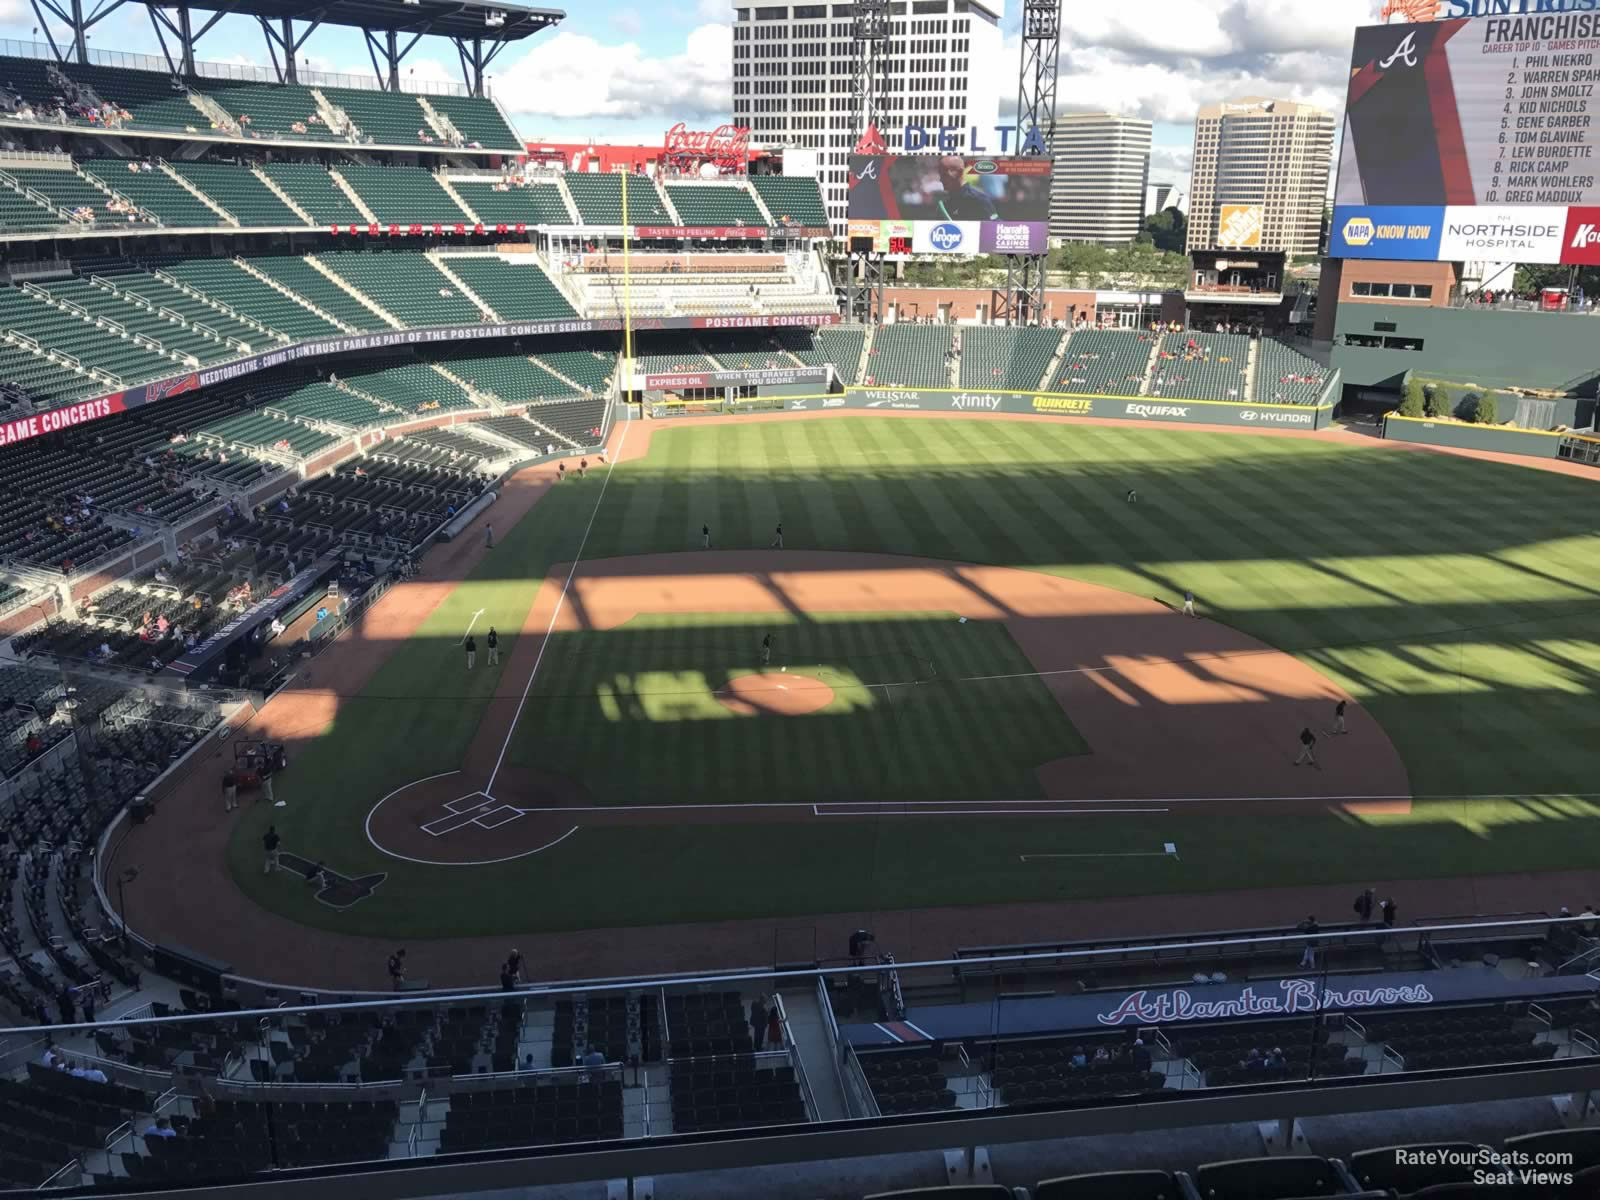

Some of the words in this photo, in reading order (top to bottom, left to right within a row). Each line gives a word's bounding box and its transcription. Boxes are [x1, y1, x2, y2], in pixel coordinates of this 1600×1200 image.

[1482, 43, 1513, 54] CAREER
[1515, 42, 1530, 53] TOP
[1532, 41, 1540, 52] 10
[1547, 40, 1576, 51] GAMES
[1512, 56, 1519, 69] 1.
[1525, 55, 1549, 68] PHIL
[1552, 53, 1592, 67] NIEKRO
[1507, 72, 1517, 84] 2.
[1523, 70, 1569, 84] WARREN
[1505, 87, 1515, 99] 3.
[1521, 87, 1549, 99] JOHN
[1551, 85, 1593, 98] SMOLTZ
[1503, 102, 1512, 114] 4.
[1519, 101, 1537, 114] KID
[1539, 100, 1587, 113] NICHOLS
[1501, 117, 1510, 129] 5.
[1516, 116, 1544, 129] GENE
[1547, 115, 1591, 128] GARBER
[904, 125, 1047, 154] DELTA
[1498, 132, 1508, 144] 6.
[1515, 131, 1538, 143] TOM
[1540, 130, 1585, 143] GLAVINE
[1499, 147, 1506, 159] 7.
[1512, 146, 1535, 158] LEW
[1537, 145, 1592, 158] BURDETTE
[1494, 161, 1504, 173] 8.
[1509, 161, 1535, 173] RICK
[1537, 160, 1569, 173] CAMP
[1491, 176, 1501, 188] 9.
[1507, 175, 1539, 188] MARK
[1541, 175, 1594, 188] WOHLERS
[1485, 190, 1500, 203] 10.
[1505, 190, 1534, 203] GREG
[1535, 190, 1583, 203] MADDUX
[648, 228, 670, 236] TASTE
[672, 228, 685, 236] THE
[687, 228, 716, 236] FEELING
[932, 227, 961, 248] Kroger
[1347, 225, 1370, 238] NAPA
[1376, 224, 1406, 239] KNOW
[1407, 225, 1431, 239] HOW
[1449, 224, 1559, 238] NORTHSIDE
[1465, 239, 1535, 249] HOSPITAL
[705, 317, 769, 328] POSTGAME
[772, 314, 832, 327] CONCERTS
[200, 358, 258, 386] NEEDTOBREATHE
[263, 351, 287, 368] COMING
[288, 350, 295, 360] TO
[296, 340, 341, 358] SUNTRUST
[343, 337, 367, 350] PARK
[369, 336, 381, 347] AS
[383, 333, 404, 345] PART
[408, 332, 422, 342] OF
[426, 330, 447, 340] THE
[451, 325, 508, 339] POSTGAME
[510, 323, 557, 335] CONCERT
[559, 321, 592, 332] SERIES
[649, 377, 687, 387] EXPRESS
[688, 376, 703, 386] OIL
[715, 373, 740, 381] WHEN
[743, 371, 761, 379] THE
[762, 370, 795, 378] BRAVES
[766, 377, 796, 385] SCORE!
[865, 391, 918, 402] WELLSTAR
[951, 393, 1002, 410] xfinity
[1032, 396, 1092, 410] QUIKRETE
[42, 398, 110, 433] CONCERTS
[1125, 403, 1191, 417] EQUIFAX
[1260, 412, 1312, 424] HYUNDAI
[1097, 986, 1284, 1026] Atlanta
[1280, 978, 1434, 1013] Braves
